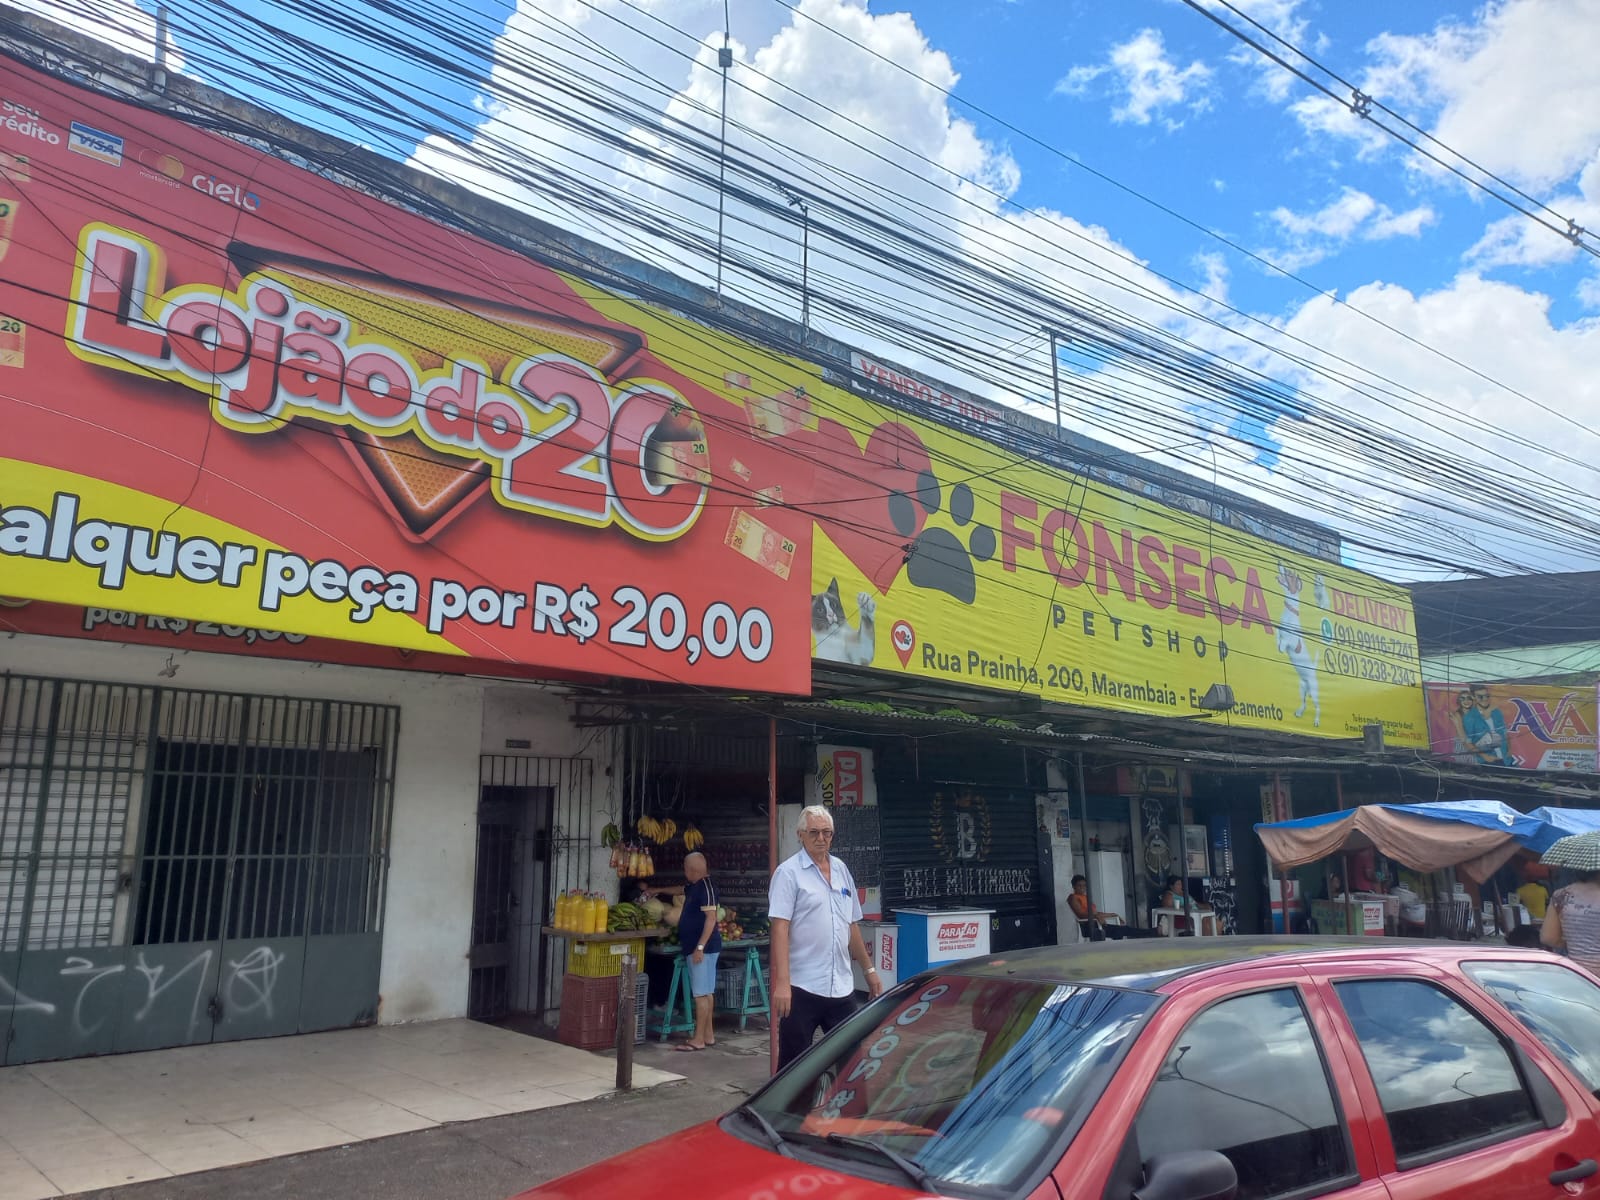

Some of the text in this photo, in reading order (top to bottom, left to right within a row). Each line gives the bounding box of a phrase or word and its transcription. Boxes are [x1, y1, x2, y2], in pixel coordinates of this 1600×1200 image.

[3, 101, 40, 120] seu
[79, 135, 116, 156] VISA
[80, 237, 705, 530] Lojão do 20
[693, 443, 705, 454] 20
[782, 540, 794, 553] 20
[1001, 490, 1274, 635] FONSECA
[0, 492, 774, 665] alquer peça por R$ 20,00
[1332, 588, 1407, 633] DELIVERY
[1334, 622, 1354, 649] (91)
[922, 643, 961, 673] Rua
[968, 650, 1043, 689] Prainha,
[1047, 664, 1088, 696] 200,
[1092, 671, 1177, 706] Marambaia
[1338, 650, 1358, 678] (91)
[1507, 692, 1593, 744] AVA
